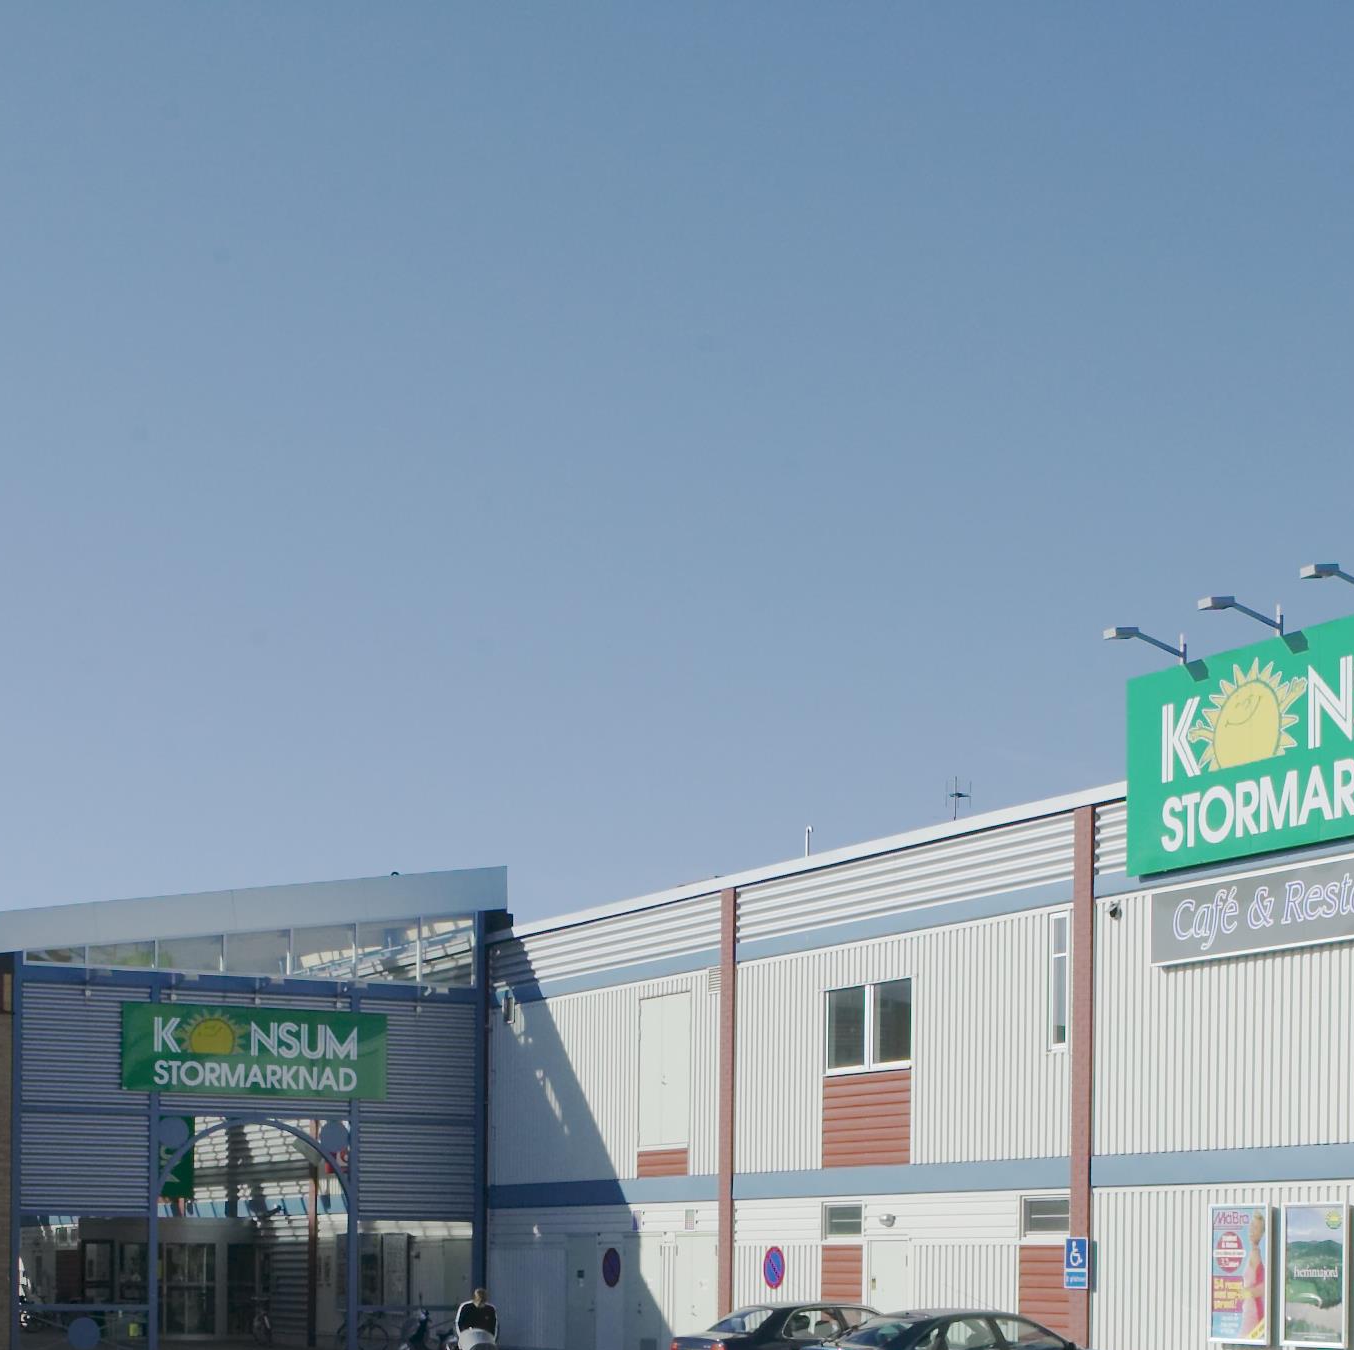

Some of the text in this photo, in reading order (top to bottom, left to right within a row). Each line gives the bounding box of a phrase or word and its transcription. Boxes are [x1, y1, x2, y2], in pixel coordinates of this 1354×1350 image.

[1172, 886, 1239, 950] Café
[1247, 886, 1274, 930] &
[153, 1059, 358, 1093] STORMARKNAD
